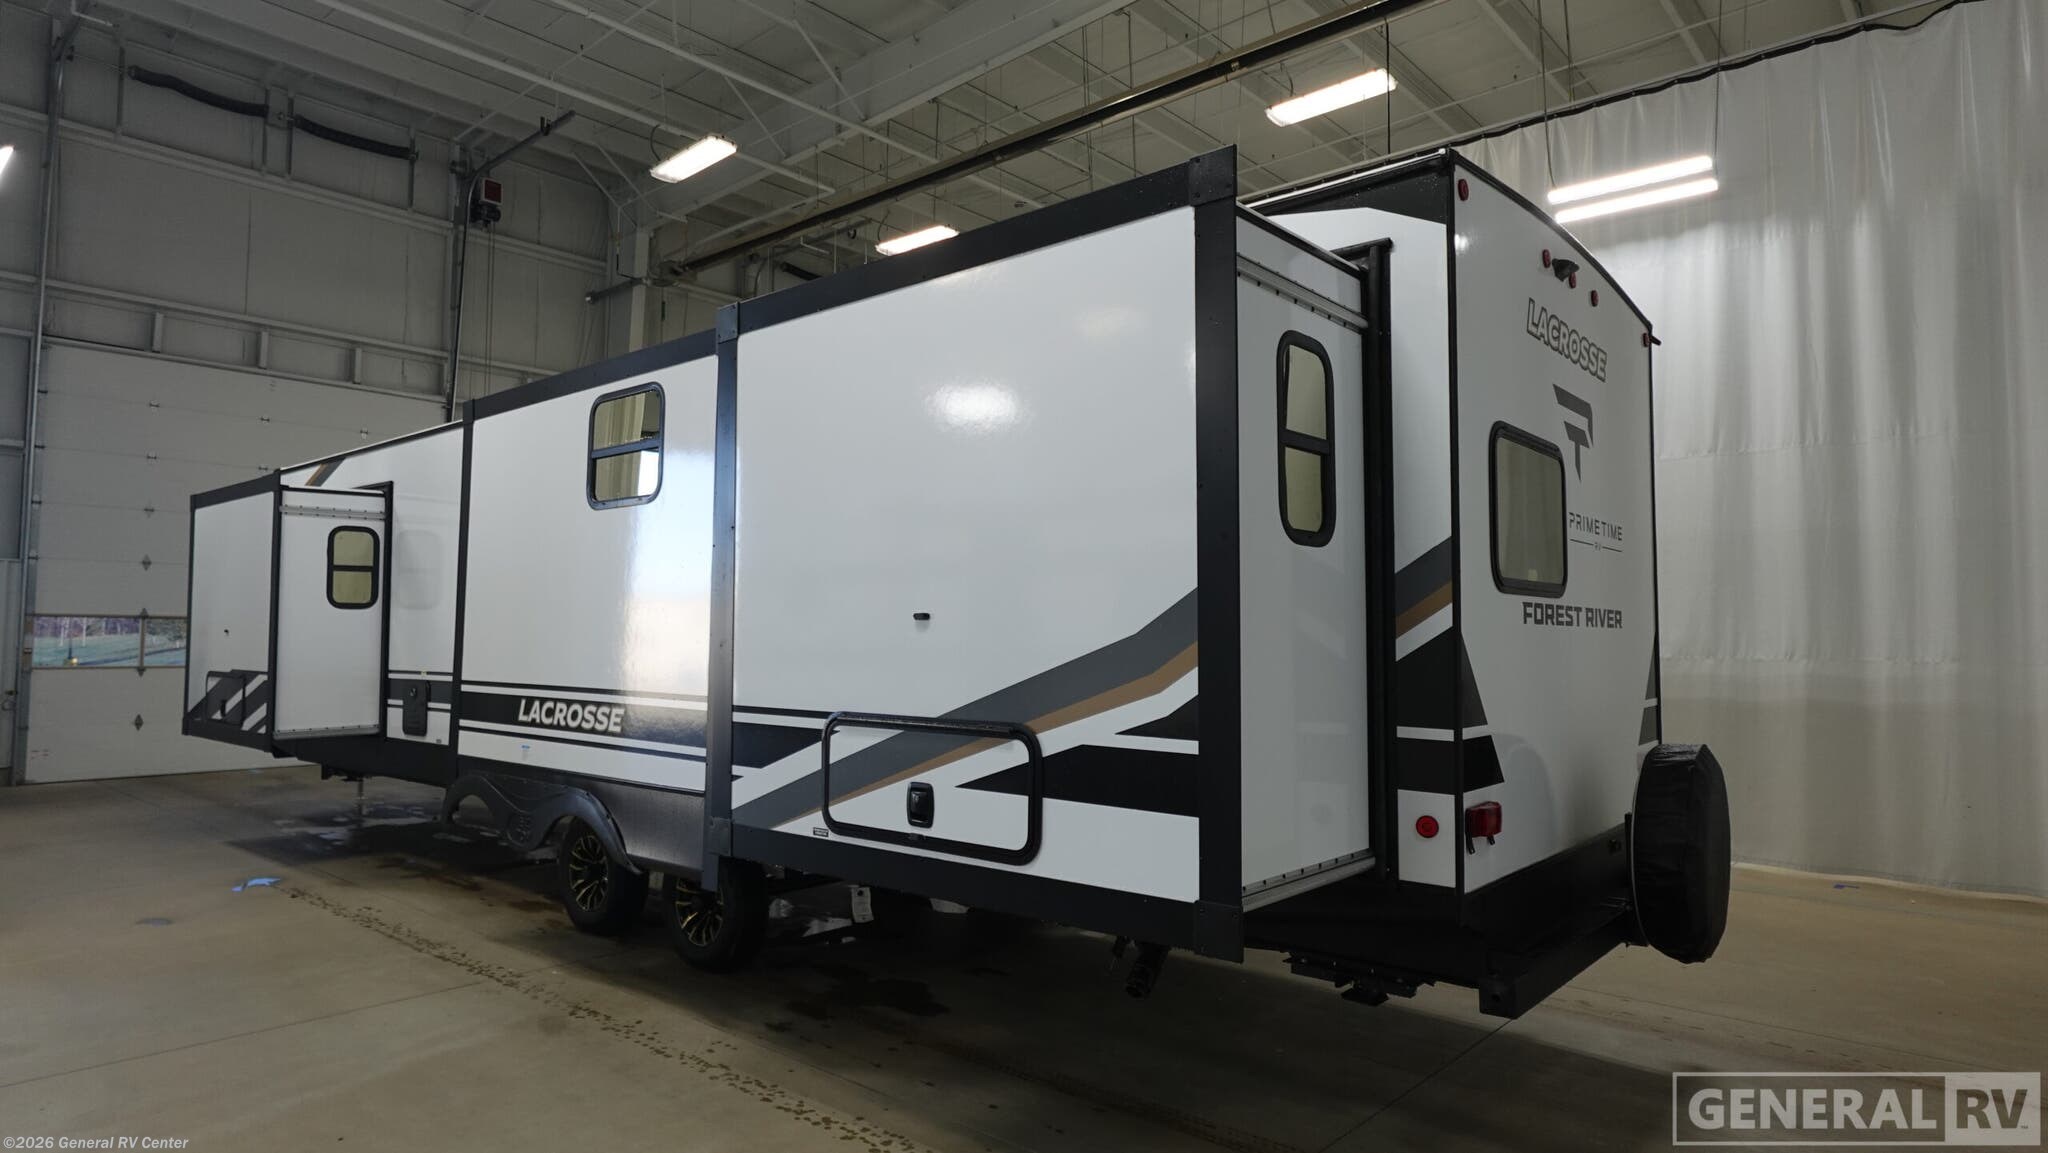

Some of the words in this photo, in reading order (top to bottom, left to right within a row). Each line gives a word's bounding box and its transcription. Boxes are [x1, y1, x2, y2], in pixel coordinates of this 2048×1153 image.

[1527, 297, 1607, 382] LACROSSE
[1522, 601, 1582, 627] FOREST
[1585, 607, 1623, 629] RIVER
[518, 698, 625, 733] LACROSSE
